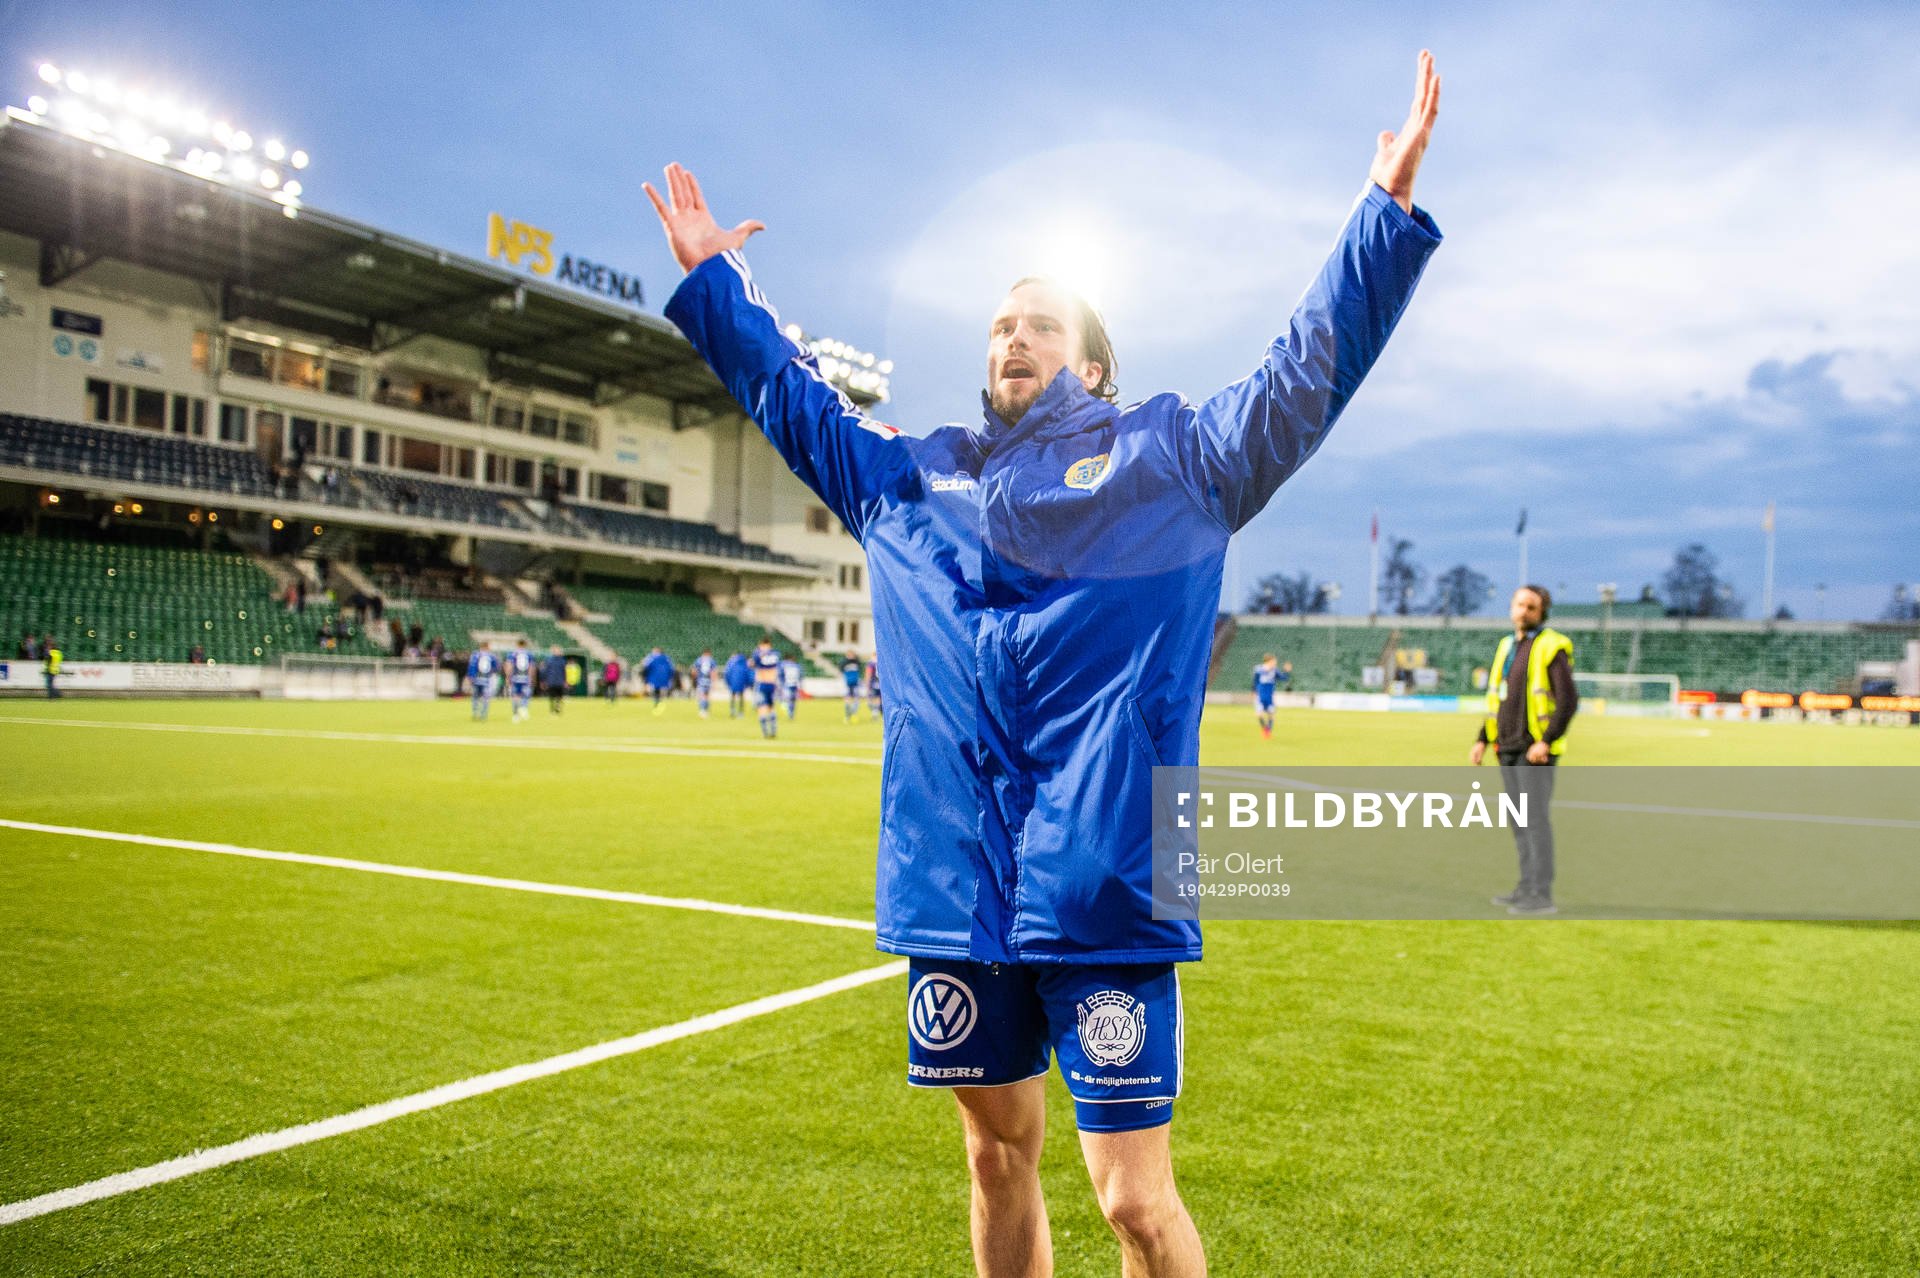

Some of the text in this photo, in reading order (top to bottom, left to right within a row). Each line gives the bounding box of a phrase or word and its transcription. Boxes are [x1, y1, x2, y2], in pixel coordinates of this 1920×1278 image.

[556, 252, 645, 305] ARENA
[1088, 1015, 1133, 1041] HSB
[1096, 1076, 1150, 1086] möjligheterna
[1150, 1075, 1162, 1083] bor
